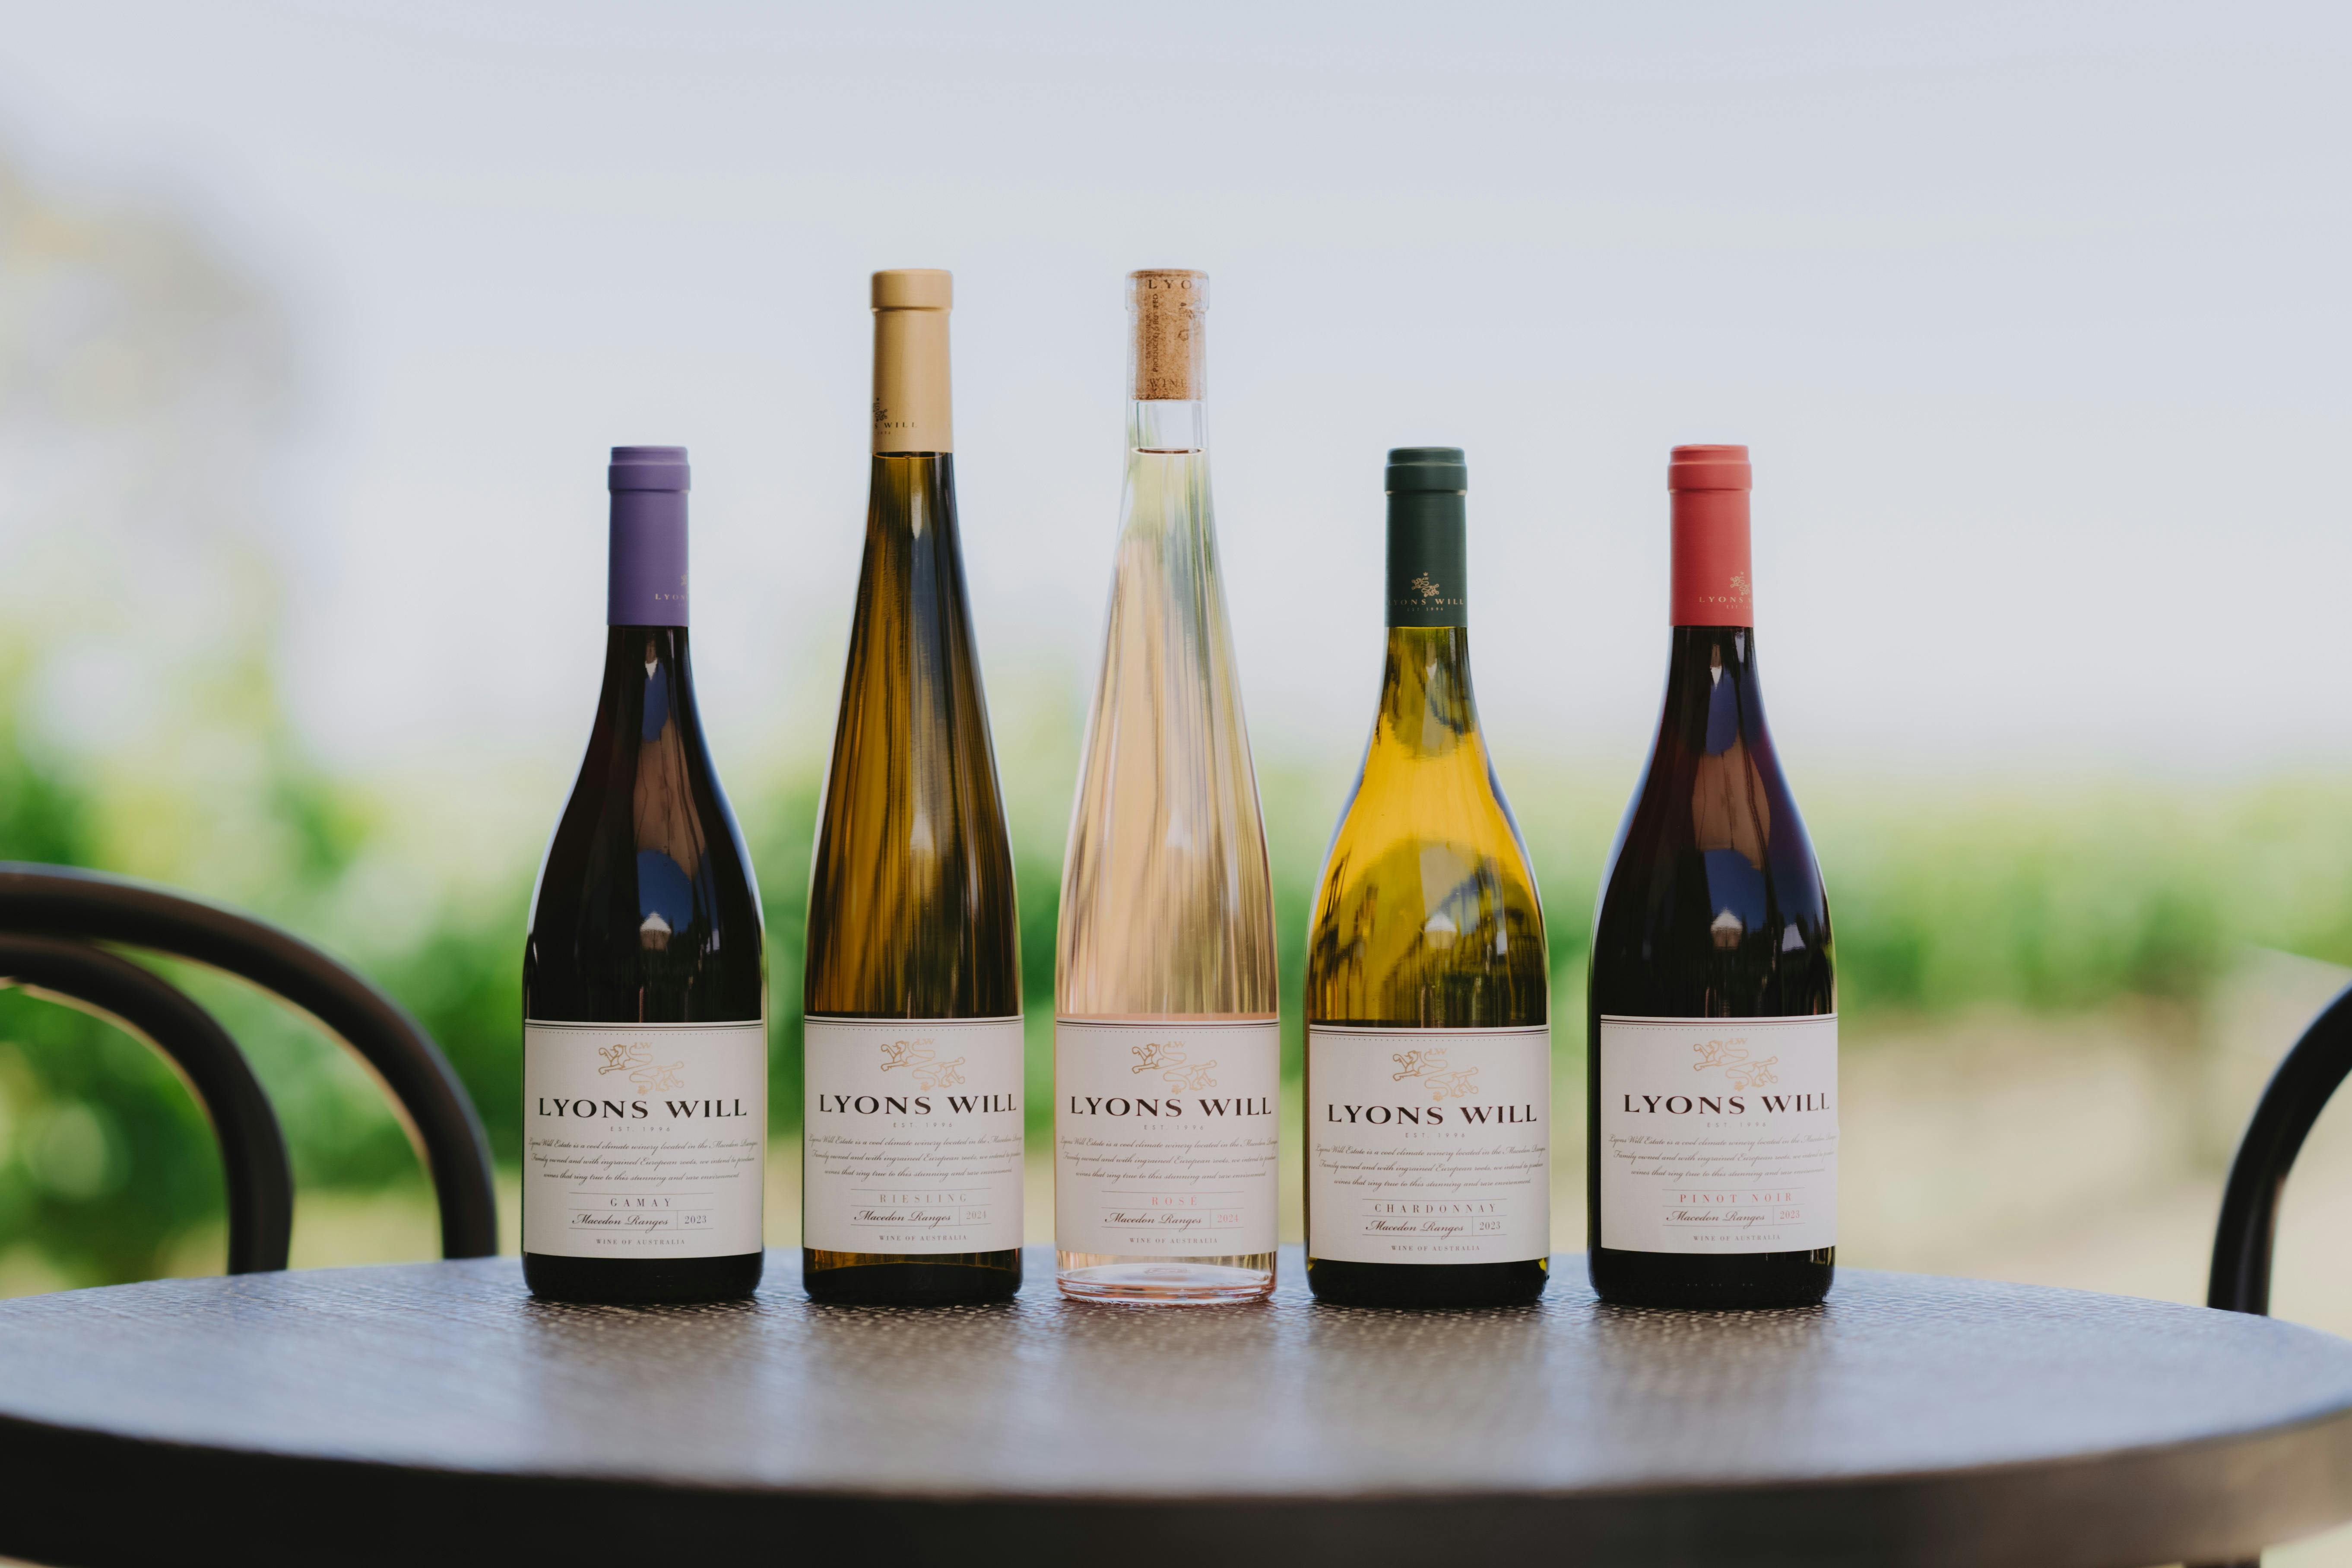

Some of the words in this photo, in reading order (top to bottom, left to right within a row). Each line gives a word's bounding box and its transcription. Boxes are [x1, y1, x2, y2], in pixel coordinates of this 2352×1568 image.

[539, 1098, 649, 1119] LYONS
[664, 1099, 747, 1118] WILL
[819, 1094, 931, 1115] LYONS
[947, 1093, 1017, 1114] WILL
[1071, 1096, 1182, 1117] LYONS
[1198, 1097, 1271, 1117] WILL
[1624, 1094, 1745, 1115] LYONS
[1761, 1093, 1829, 1113] WILL
[1328, 1104, 1443, 1125] LYONS
[1459, 1105, 1537, 1124] WILL
[541, 1139, 554, 1147] Will
[631, 1144, 659, 1156] winery
[697, 1139, 708, 1149] the
[1346, 1145, 1365, 1154] Estate
[1381, 1147, 1398, 1156] cool
[1427, 1150, 1453, 1162] winery
[1456, 1147, 1483, 1156] located
[1492, 1144, 1502, 1155] the
[1503, 1146, 1530, 1154] Macedon
[560, 1169, 572, 1179] that
[574, 1173, 588, 1185] ring
[615, 1171, 628, 1180] this
[630, 1174, 666, 1187] stunning
[842, 1166, 854, 1175] that
[857, 1171, 870, 1182] ring
[897, 1167, 911, 1176] this
[913, 1171, 949, 1182] stunning
[1092, 1168, 1105, 1178] that
[1107, 1172, 1121, 1184] ring
[1148, 1169, 1161, 1178] this
[1164, 1173, 1199, 1185] stunning
[1651, 1166, 1666, 1175] that
[1668, 1171, 1683, 1182] ring
[1712, 1167, 1726, 1176] this
[1728, 1171, 1762, 1182] stunning
[1352, 1175, 1365, 1185] that
[1368, 1180, 1382, 1192] ring
[1410, 1177, 1423, 1187] this
[1426, 1181, 1461, 1193] stunning
[611, 1198, 671, 1207] GAMAY
[880, 1193, 967, 1203] RIESLING
[1151, 1195, 1198, 1206] ROSÉ
[1680, 1194, 1738, 1203] PINOT
[1752, 1193, 1792, 1202] NOIR
[1375, 1204, 1496, 1213] CHARDONNAY
[1780, 1210, 1800, 1219] 2023
[572, 1213, 621, 1225] Macedon
[625, 1214, 669, 1233] Ranges
[685, 1215, 707, 1224] 2023
[854, 1210, 905, 1221] Macedon
[908, 1210, 951, 1229] Ranges
[1105, 1213, 1154, 1224] Macedon
[1159, 1213, 1202, 1232] Ranges
[1480, 1221, 1501, 1230] 2023
[1666, 1210, 1719, 1221] Macedon
[1722, 1211, 1765, 1229] Ranges
[1366, 1220, 1417, 1232] Macedon
[1420, 1221, 1464, 1240] Ranges
